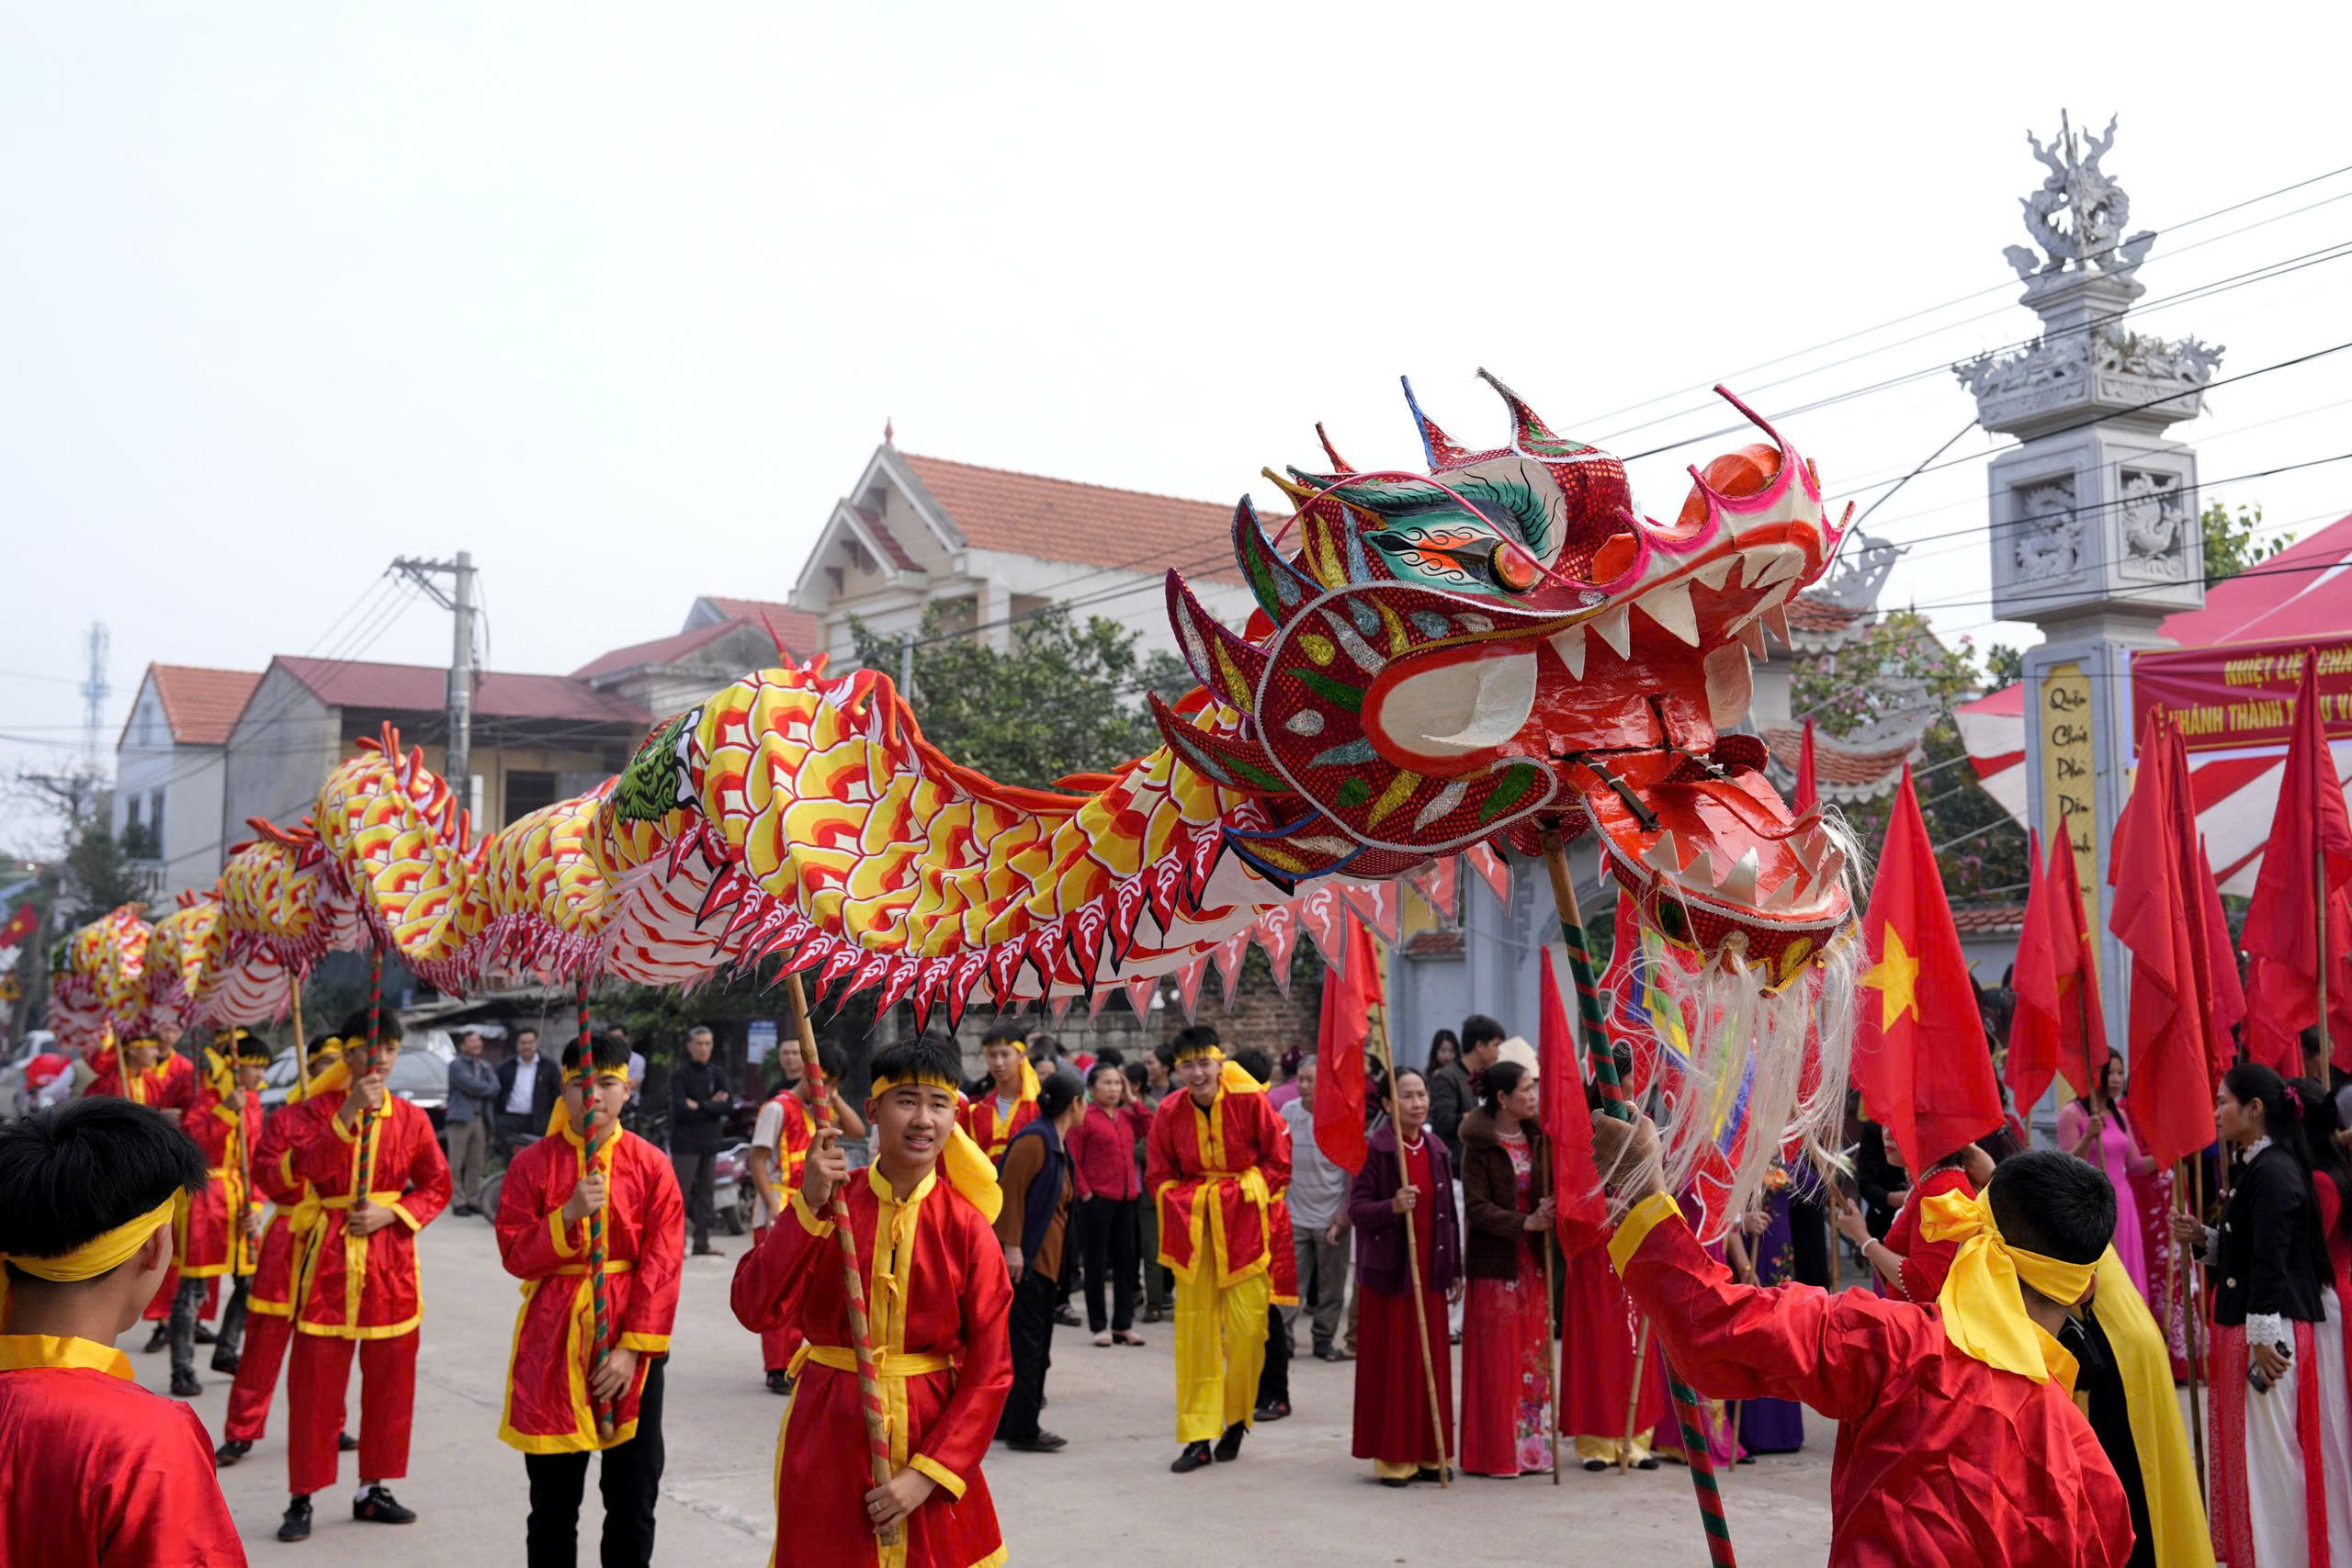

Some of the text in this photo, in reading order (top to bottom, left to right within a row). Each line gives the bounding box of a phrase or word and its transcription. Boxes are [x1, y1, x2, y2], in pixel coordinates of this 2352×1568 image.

[2224, 652, 2275, 688] NHIỆT
[2277, 648, 2305, 684] LIỆ
[2227, 696, 2284, 733] THÀNH
